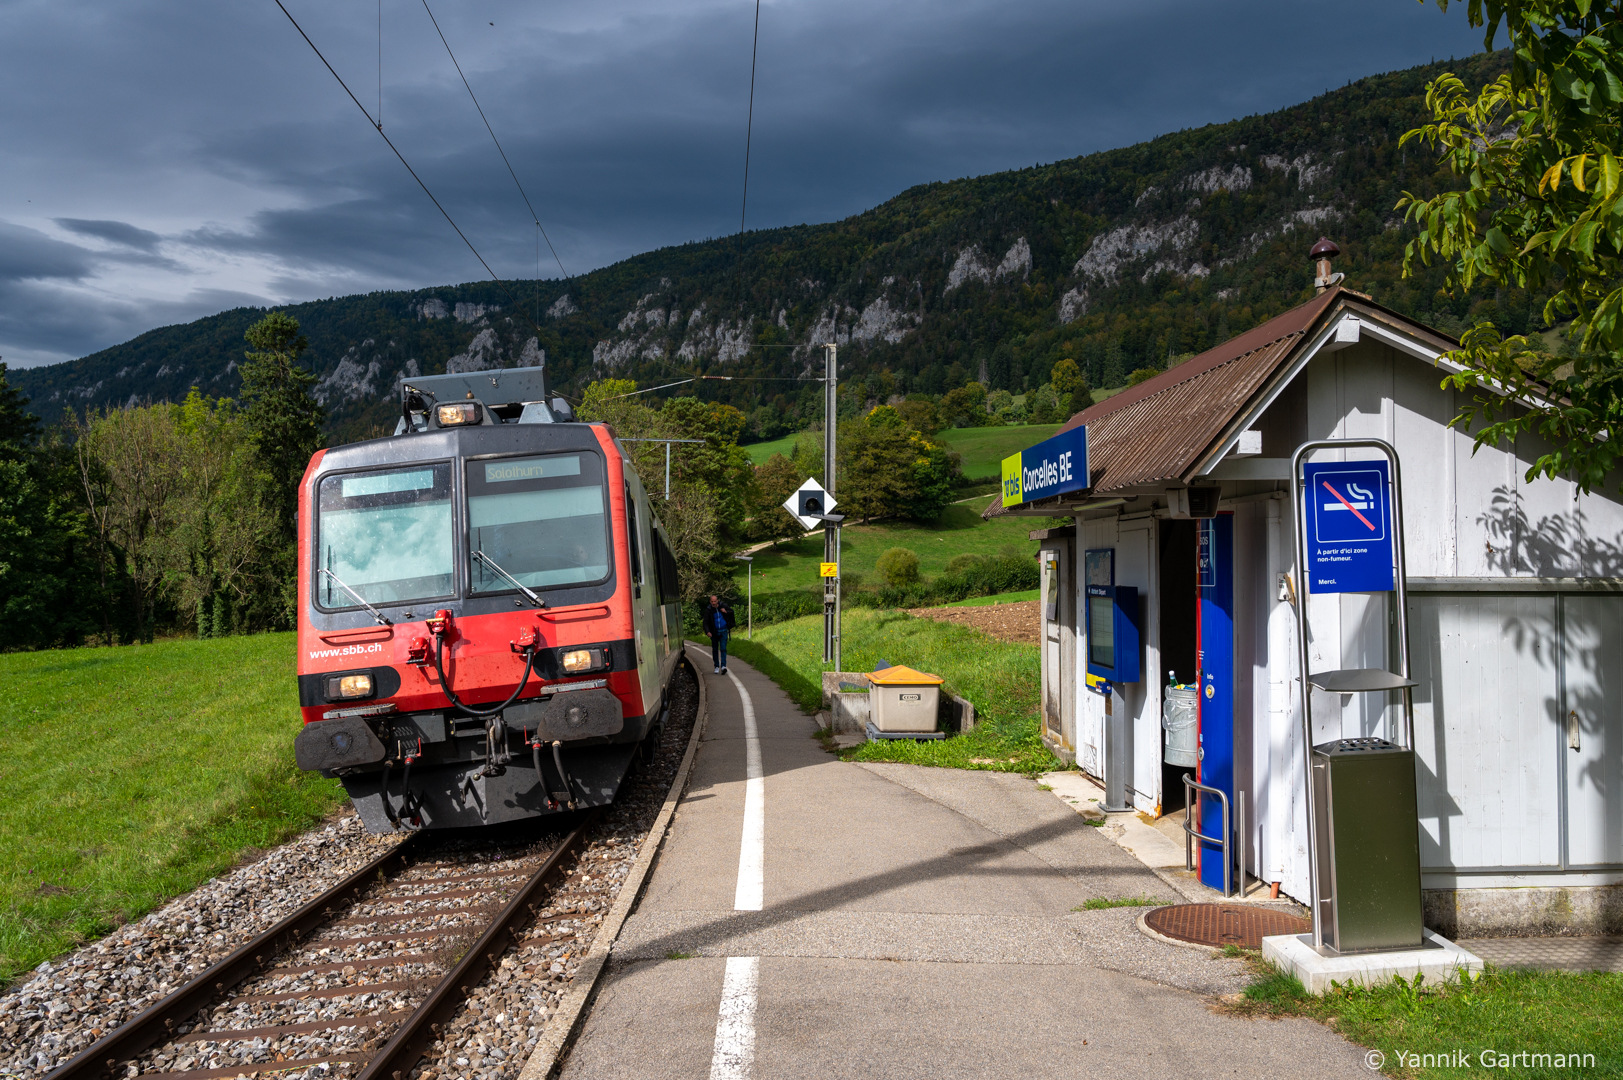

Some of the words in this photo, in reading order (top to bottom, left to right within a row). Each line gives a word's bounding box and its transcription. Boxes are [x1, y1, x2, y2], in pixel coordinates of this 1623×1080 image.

[487, 466, 543, 480] Solothurn
[1023, 459, 1058, 492] Corcelles
[1059, 451, 1072, 482] BE
[1010, 472, 1019, 496] bls
[1322, 548, 1339, 556] partir
[309, 642, 382, 659] www.sbb.ch
